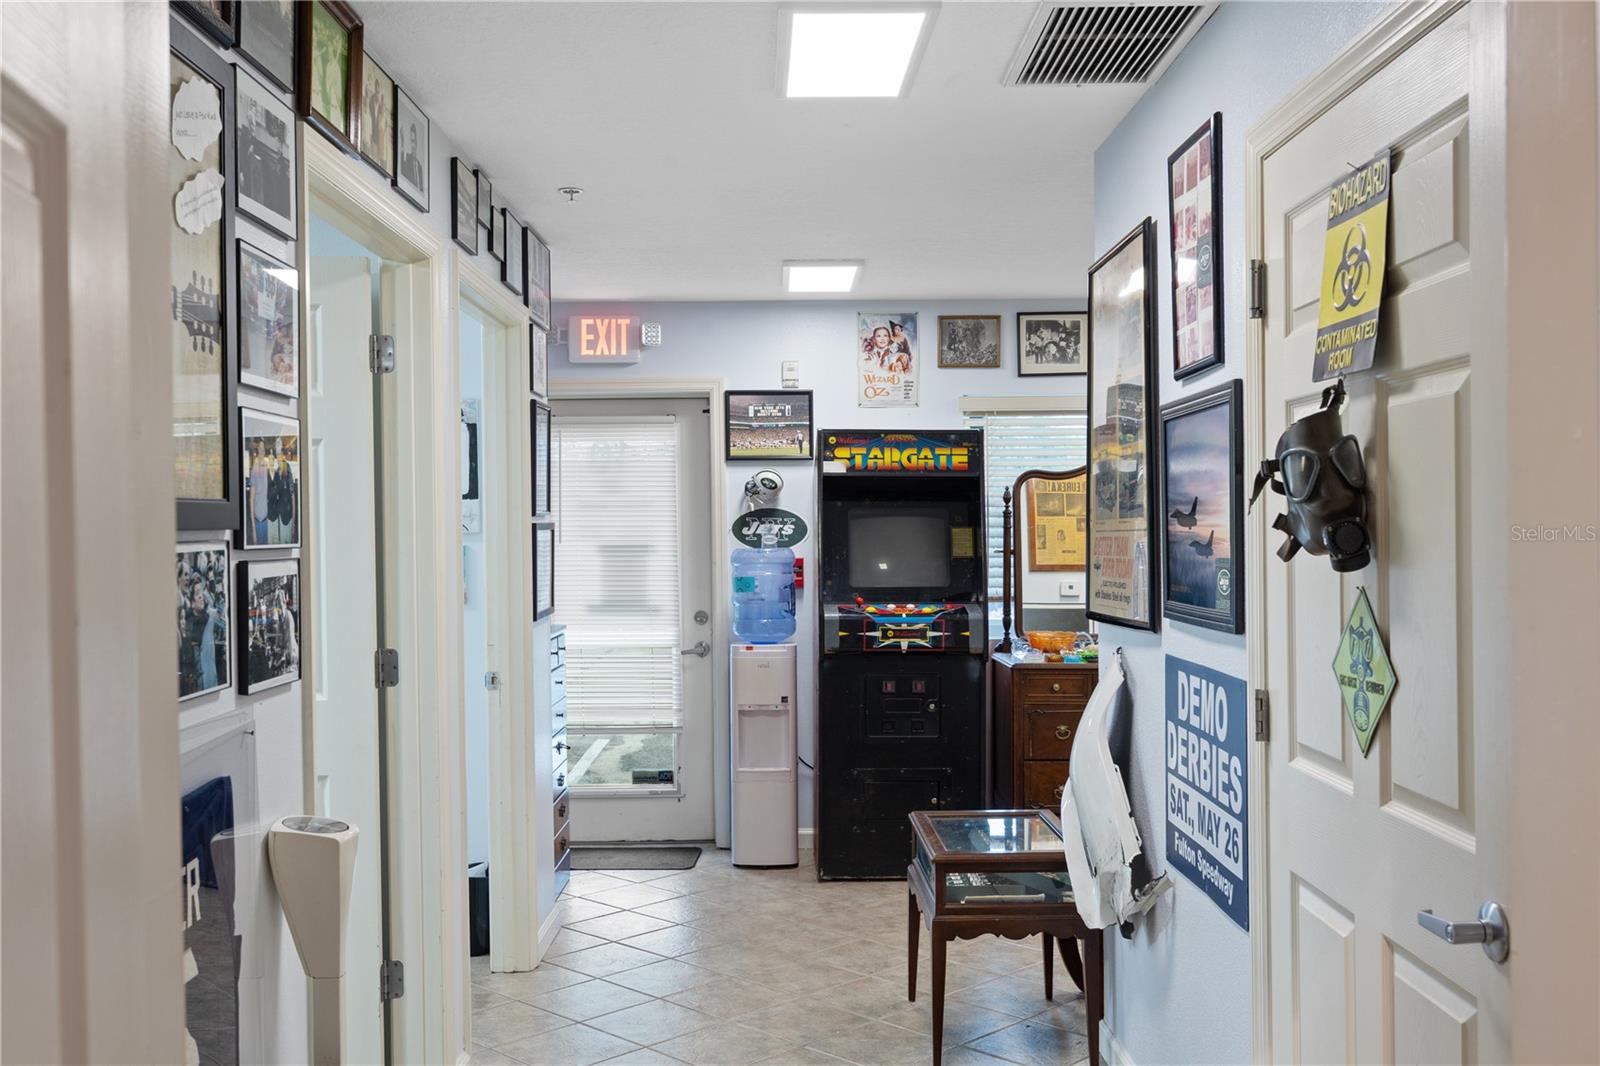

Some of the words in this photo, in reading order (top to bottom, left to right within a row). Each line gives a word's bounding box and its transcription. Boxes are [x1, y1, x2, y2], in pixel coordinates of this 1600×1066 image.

[1328, 158, 1388, 220] BIOHAZARD
[580, 318, 631, 356] EXIT
[1316, 319, 1376, 354] CONTAMINATED
[1328, 346, 1354, 371] ROOM
[863, 374, 900, 385] WIZARD
[833, 447, 969, 471] STARGATE
[741, 521, 796, 535] JETS
[1177, 670, 1228, 743] DEMO
[1167, 719, 1243, 815] DERBIES
[1170, 782, 1195, 835] SAT.,
[1197, 801, 1221, 847] MAY
[1224, 823, 1240, 865] 26
[1174, 831, 1196, 866] Fulton
[1196, 849, 1234, 905] Speedway
